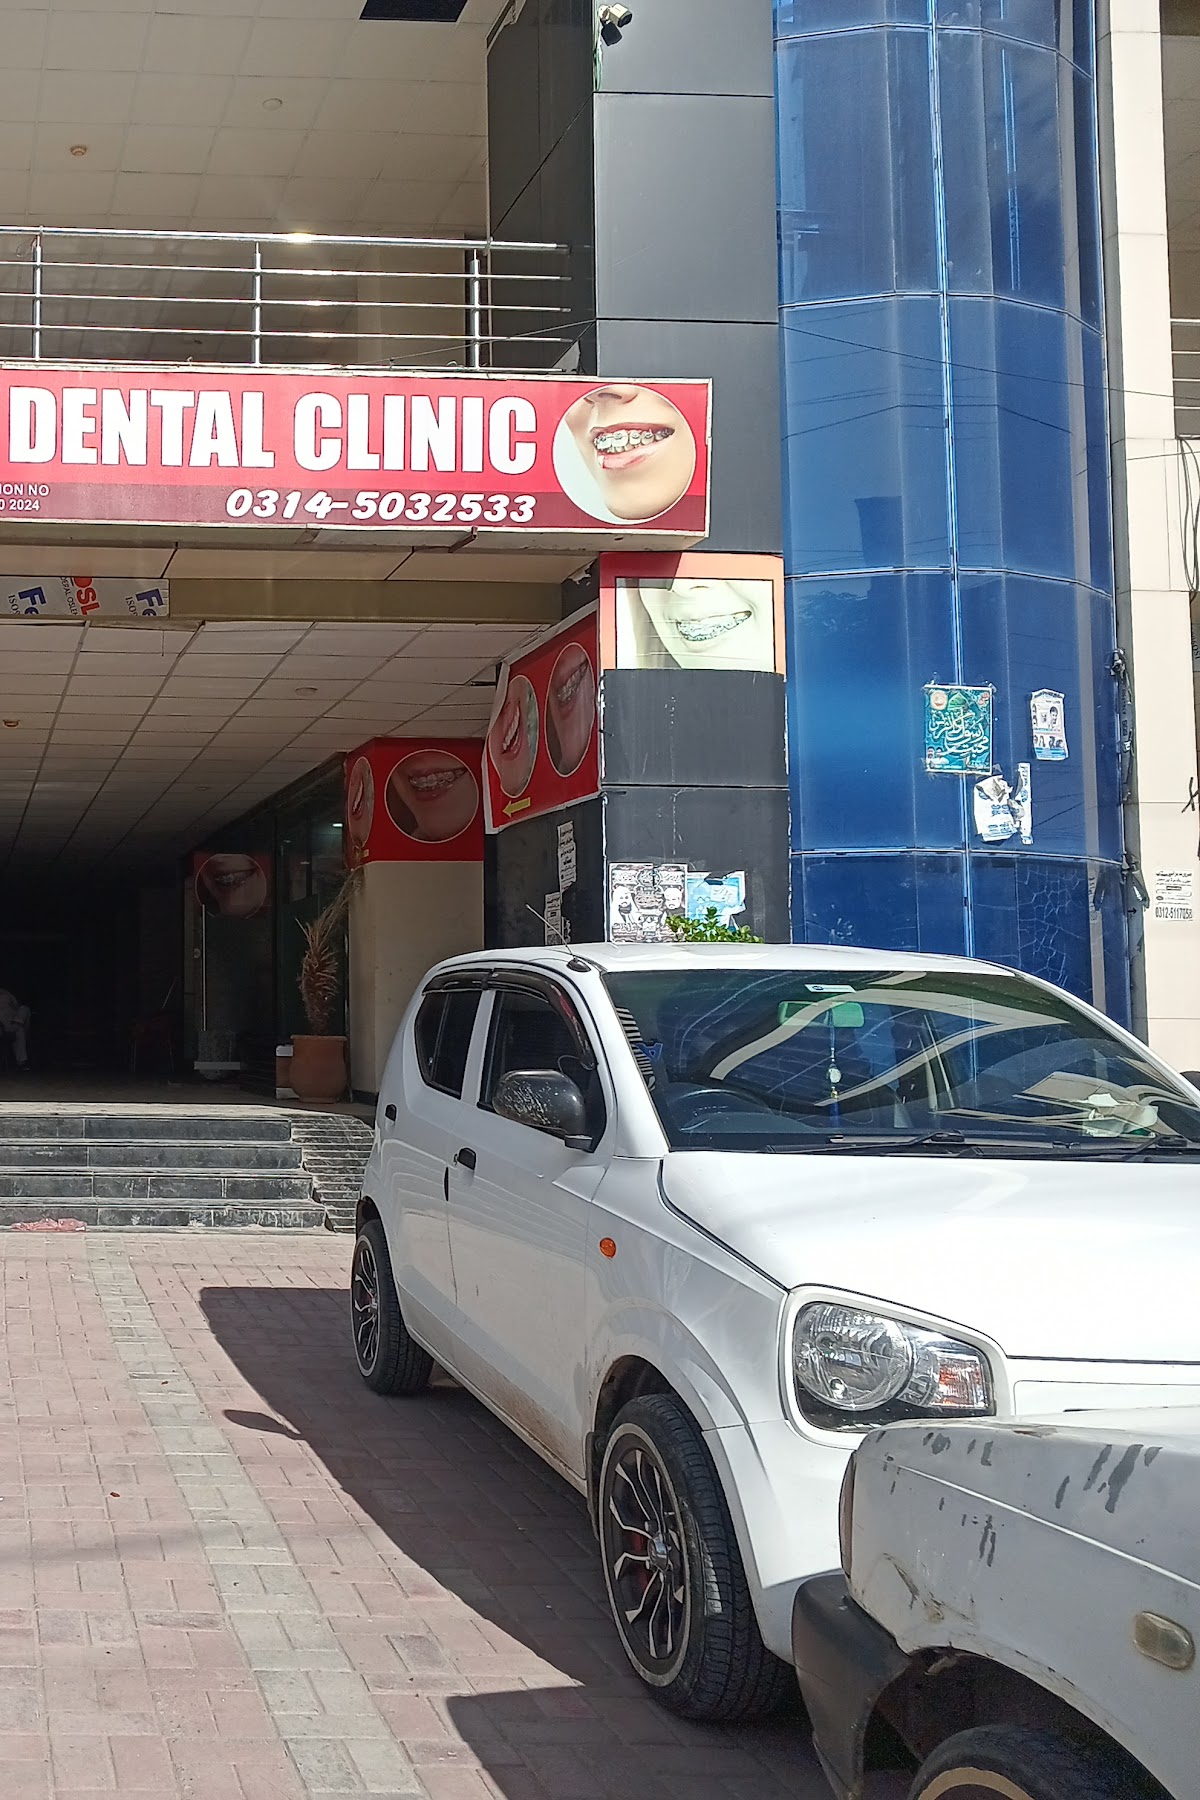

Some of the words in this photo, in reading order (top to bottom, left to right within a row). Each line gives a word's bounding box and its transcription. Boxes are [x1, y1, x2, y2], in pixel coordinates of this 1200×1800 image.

[8, 385, 275, 469] DENTAL
[293, 391, 537, 475] CLINIC
[28, 484, 50, 496] NO
[10, 500, 40, 511] 2024
[225, 488, 537, 523] 0314-5032533
